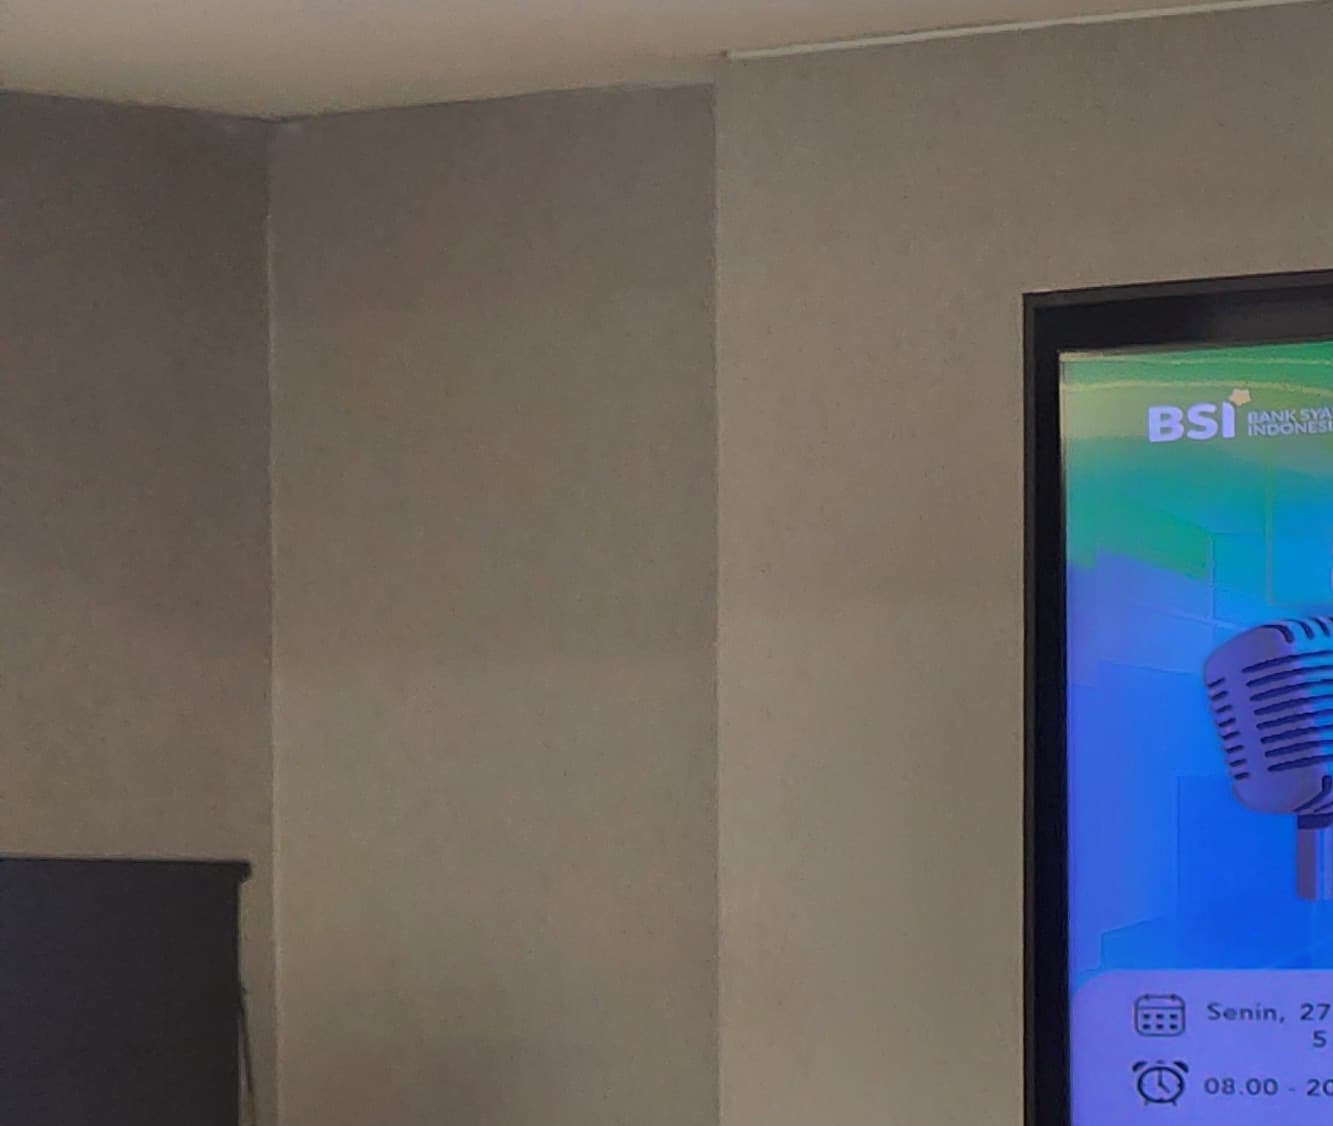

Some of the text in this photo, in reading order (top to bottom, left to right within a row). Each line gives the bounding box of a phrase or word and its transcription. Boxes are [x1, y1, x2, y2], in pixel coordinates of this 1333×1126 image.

[1147, 402, 1236, 442] BSI
[1248, 409, 1297, 425] BANK
[1206, 1002, 1286, 1024] Senin,
[1300, 1003, 1332, 1021] 27
[1311, 1030, 1327, 1049] 5
[1203, 1077, 1279, 1096] 08.00
